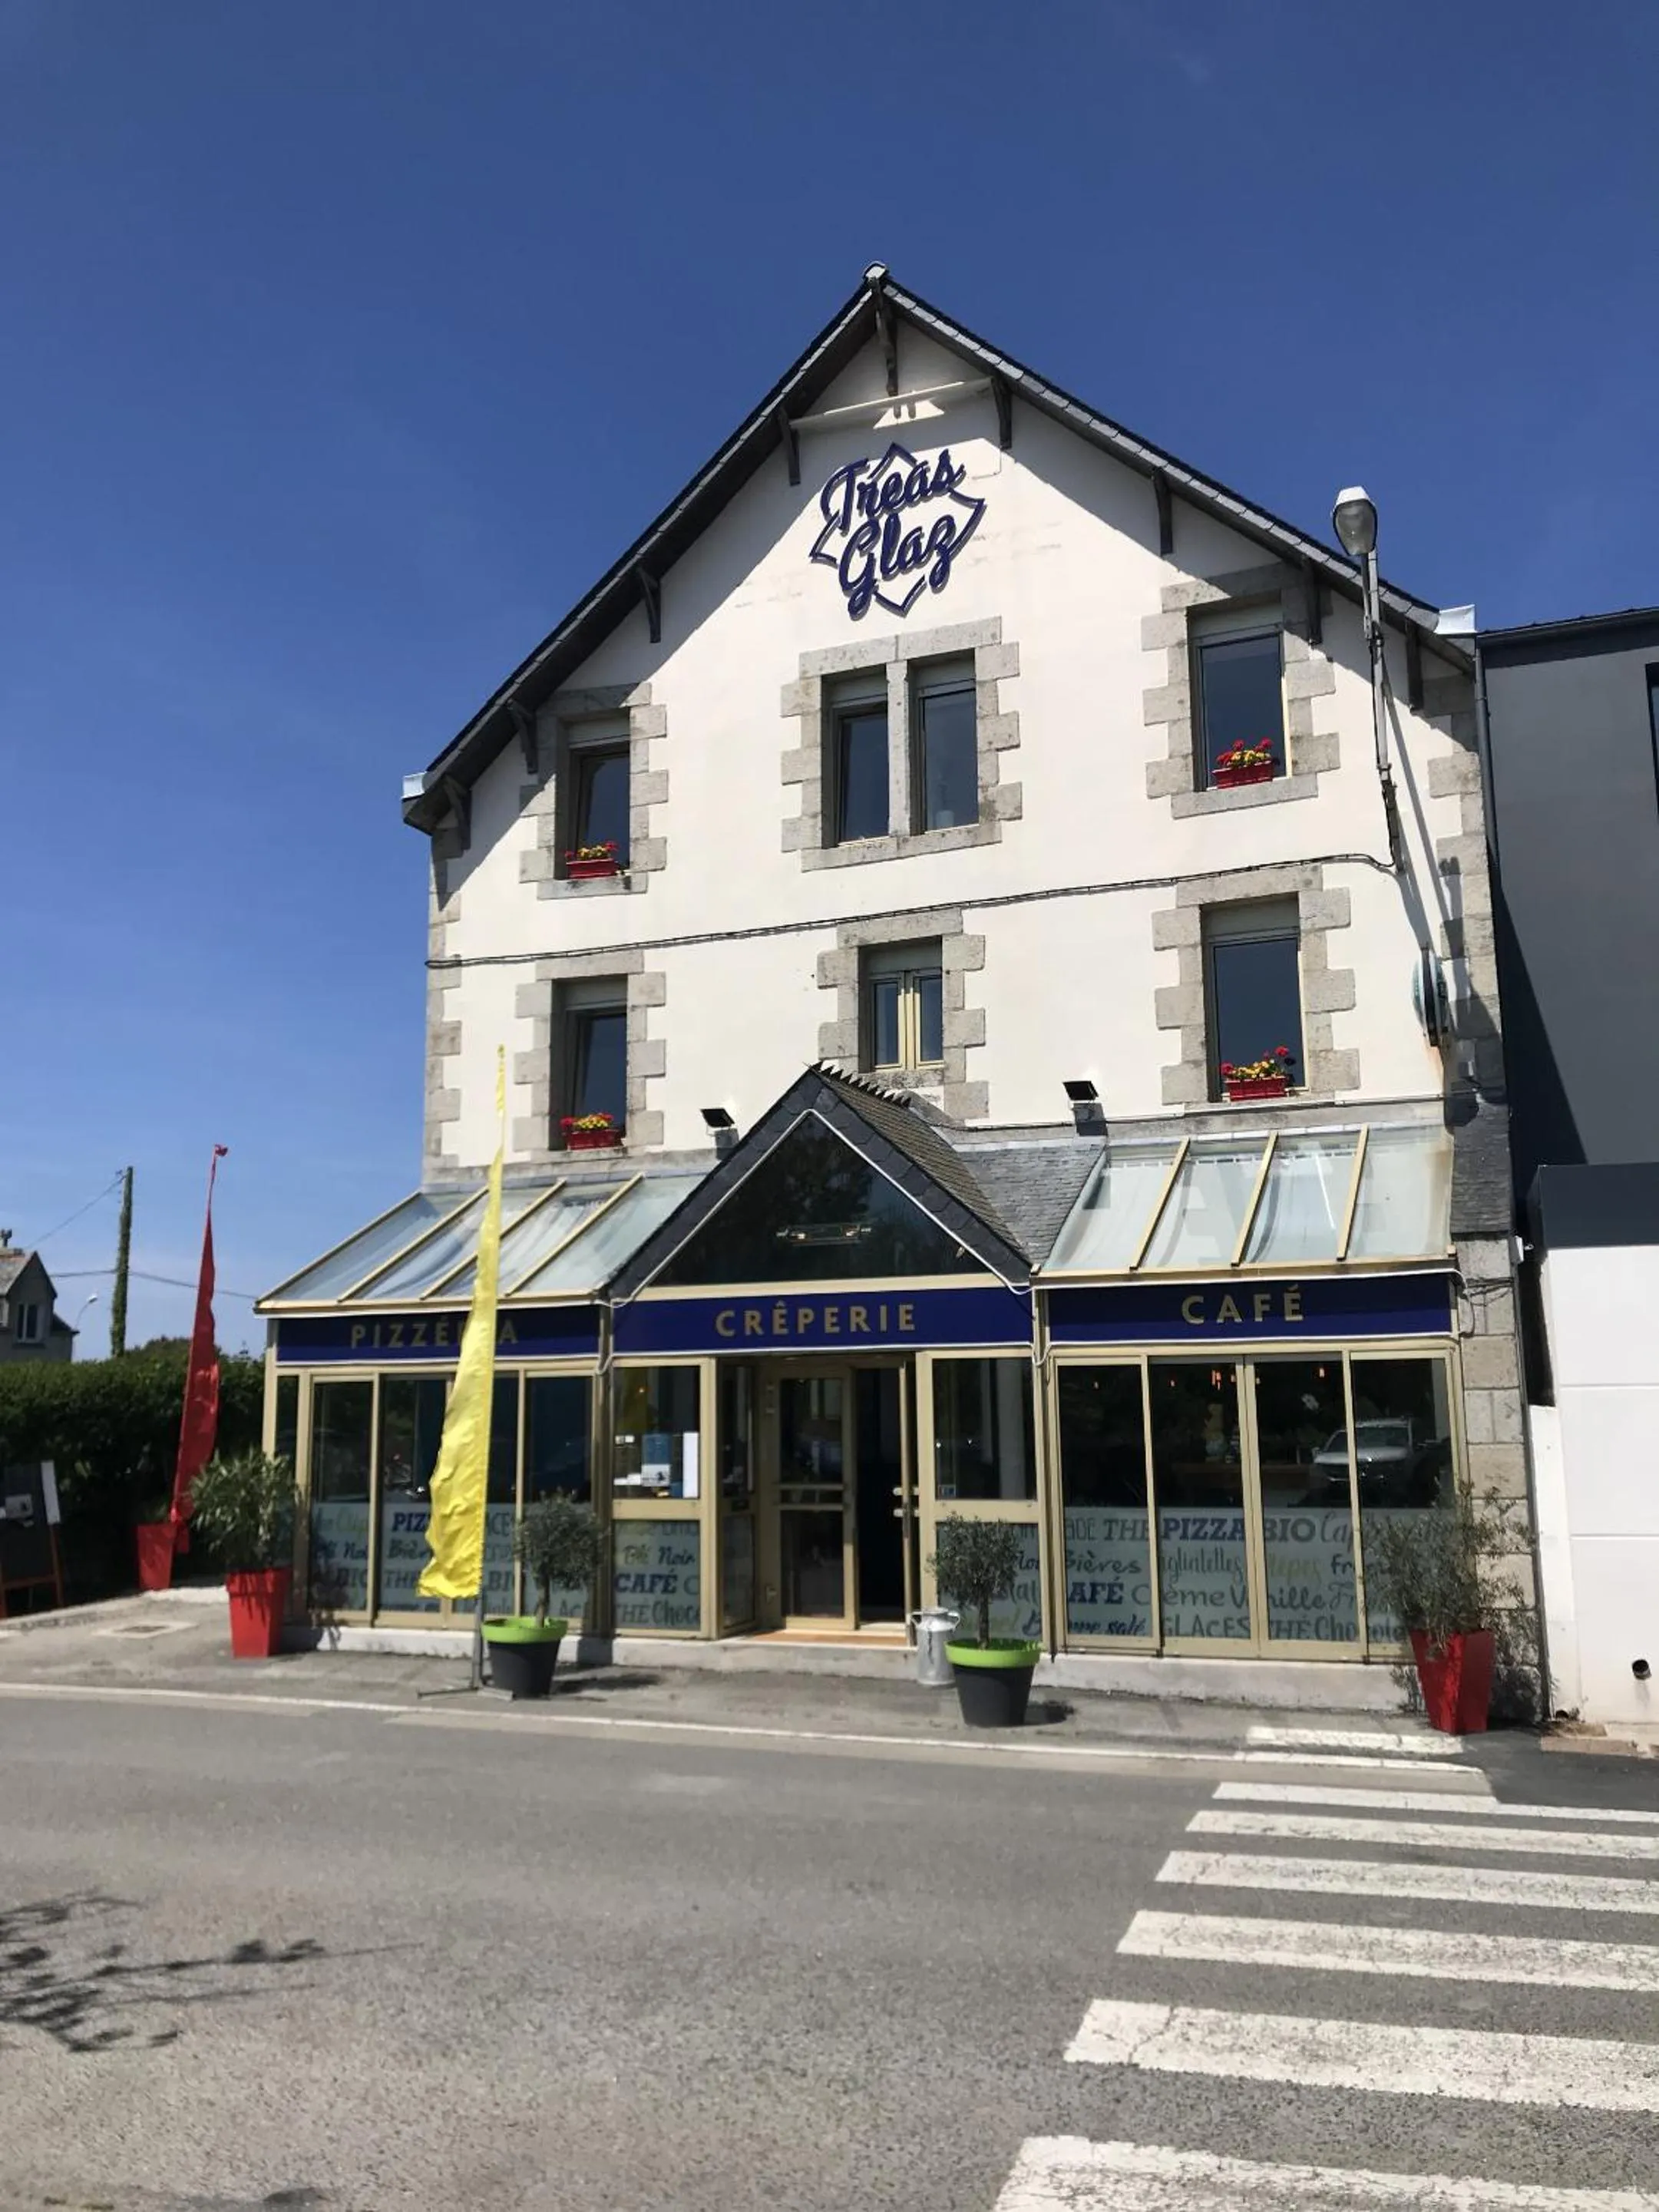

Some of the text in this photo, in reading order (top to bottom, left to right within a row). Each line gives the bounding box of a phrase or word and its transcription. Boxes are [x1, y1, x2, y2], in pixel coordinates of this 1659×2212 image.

[838, 512, 957, 620] Glaz
[715, 1300, 916, 1337] CRÊPERIE
[1181, 1284, 1304, 1324] CAFÉ
[350, 1315, 519, 1350] PIZZÉA
[1162, 1517, 1245, 1542] PIZZA
[1264, 1517, 1316, 1543] BIO
[613, 1567, 679, 1595] CAFÉ
[1068, 1576, 1125, 1605] AFÉ
[1131, 1581, 1225, 1608] Cème
[1230, 1583, 1325, 1611] Vnille
